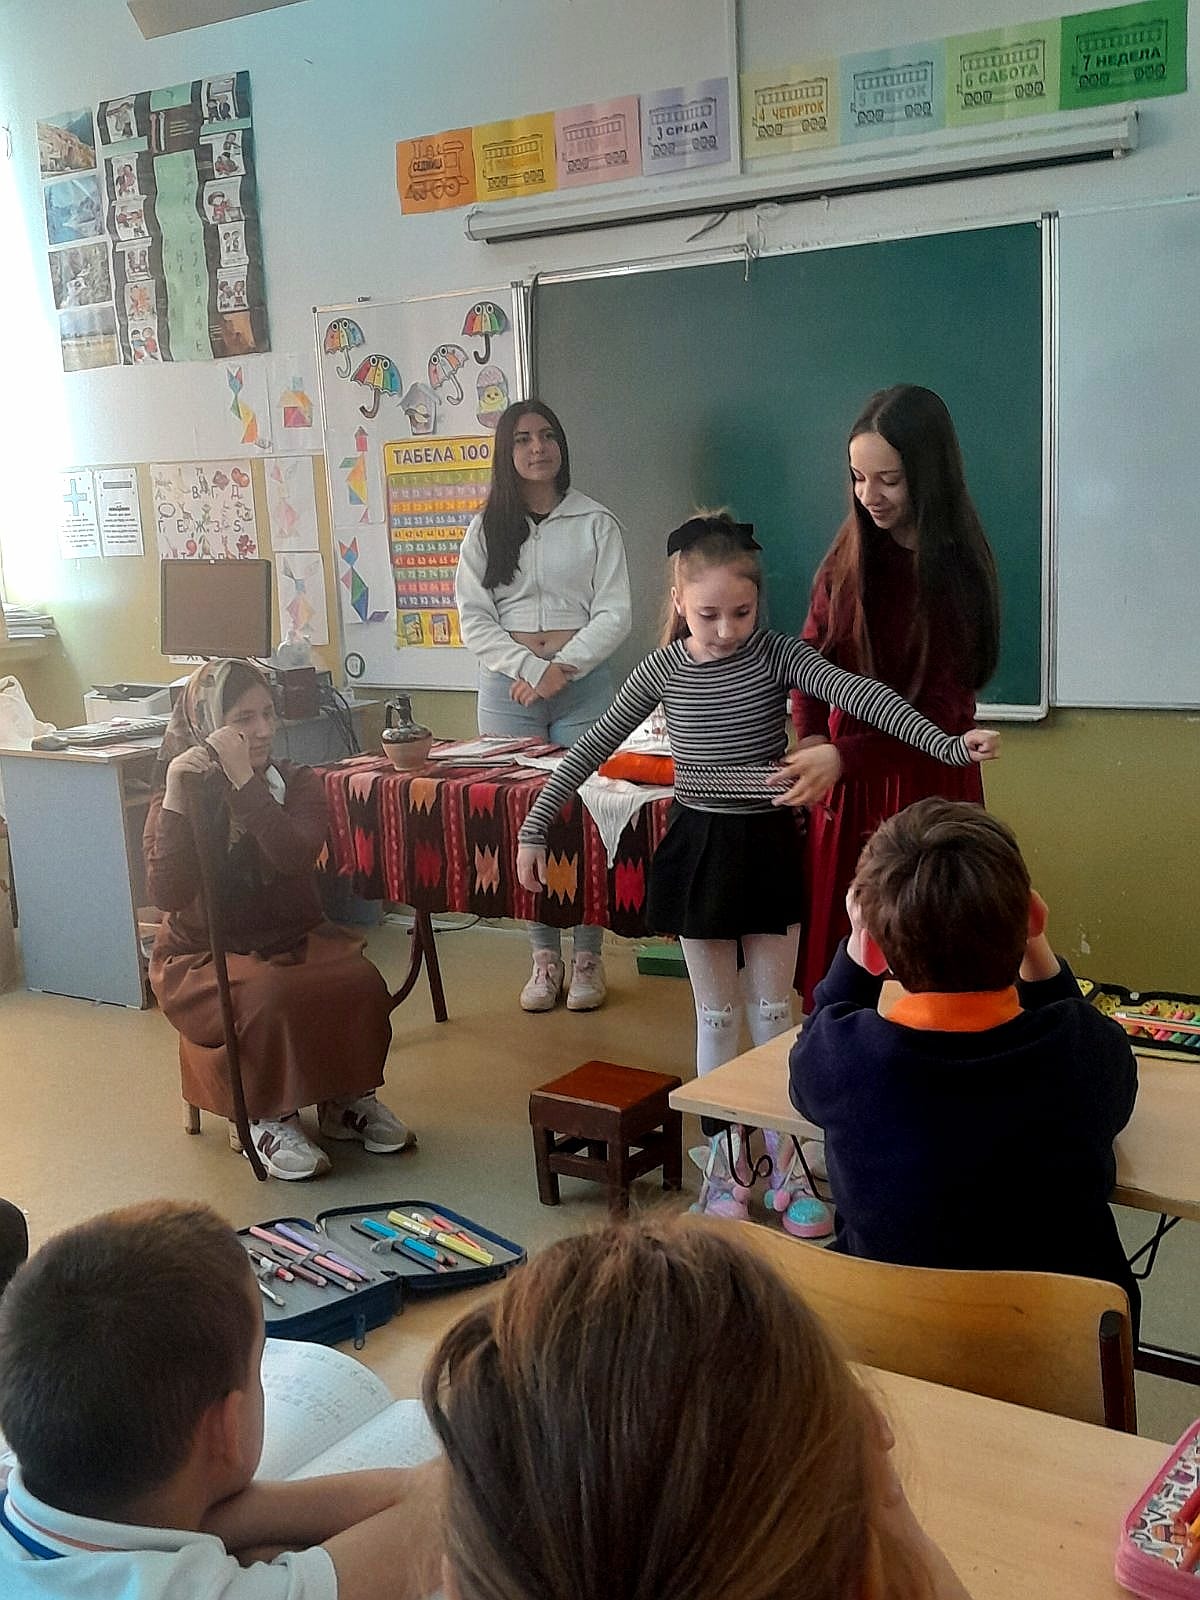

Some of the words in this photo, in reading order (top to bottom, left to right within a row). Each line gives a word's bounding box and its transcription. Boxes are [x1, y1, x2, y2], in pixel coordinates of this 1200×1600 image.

[1083, 54, 1091, 71] 7
[1096, 47, 1161, 67] НЕДЕЛА
[966, 73, 973, 87] 6
[978, 63, 1039, 84] САБОТА
[772, 100, 824, 120] ЧЕТВРТОК
[666, 120, 709, 136] СРЕДА
[393, 446, 454, 464] ТАБЕЛА
[460, 444, 489, 460] 100
